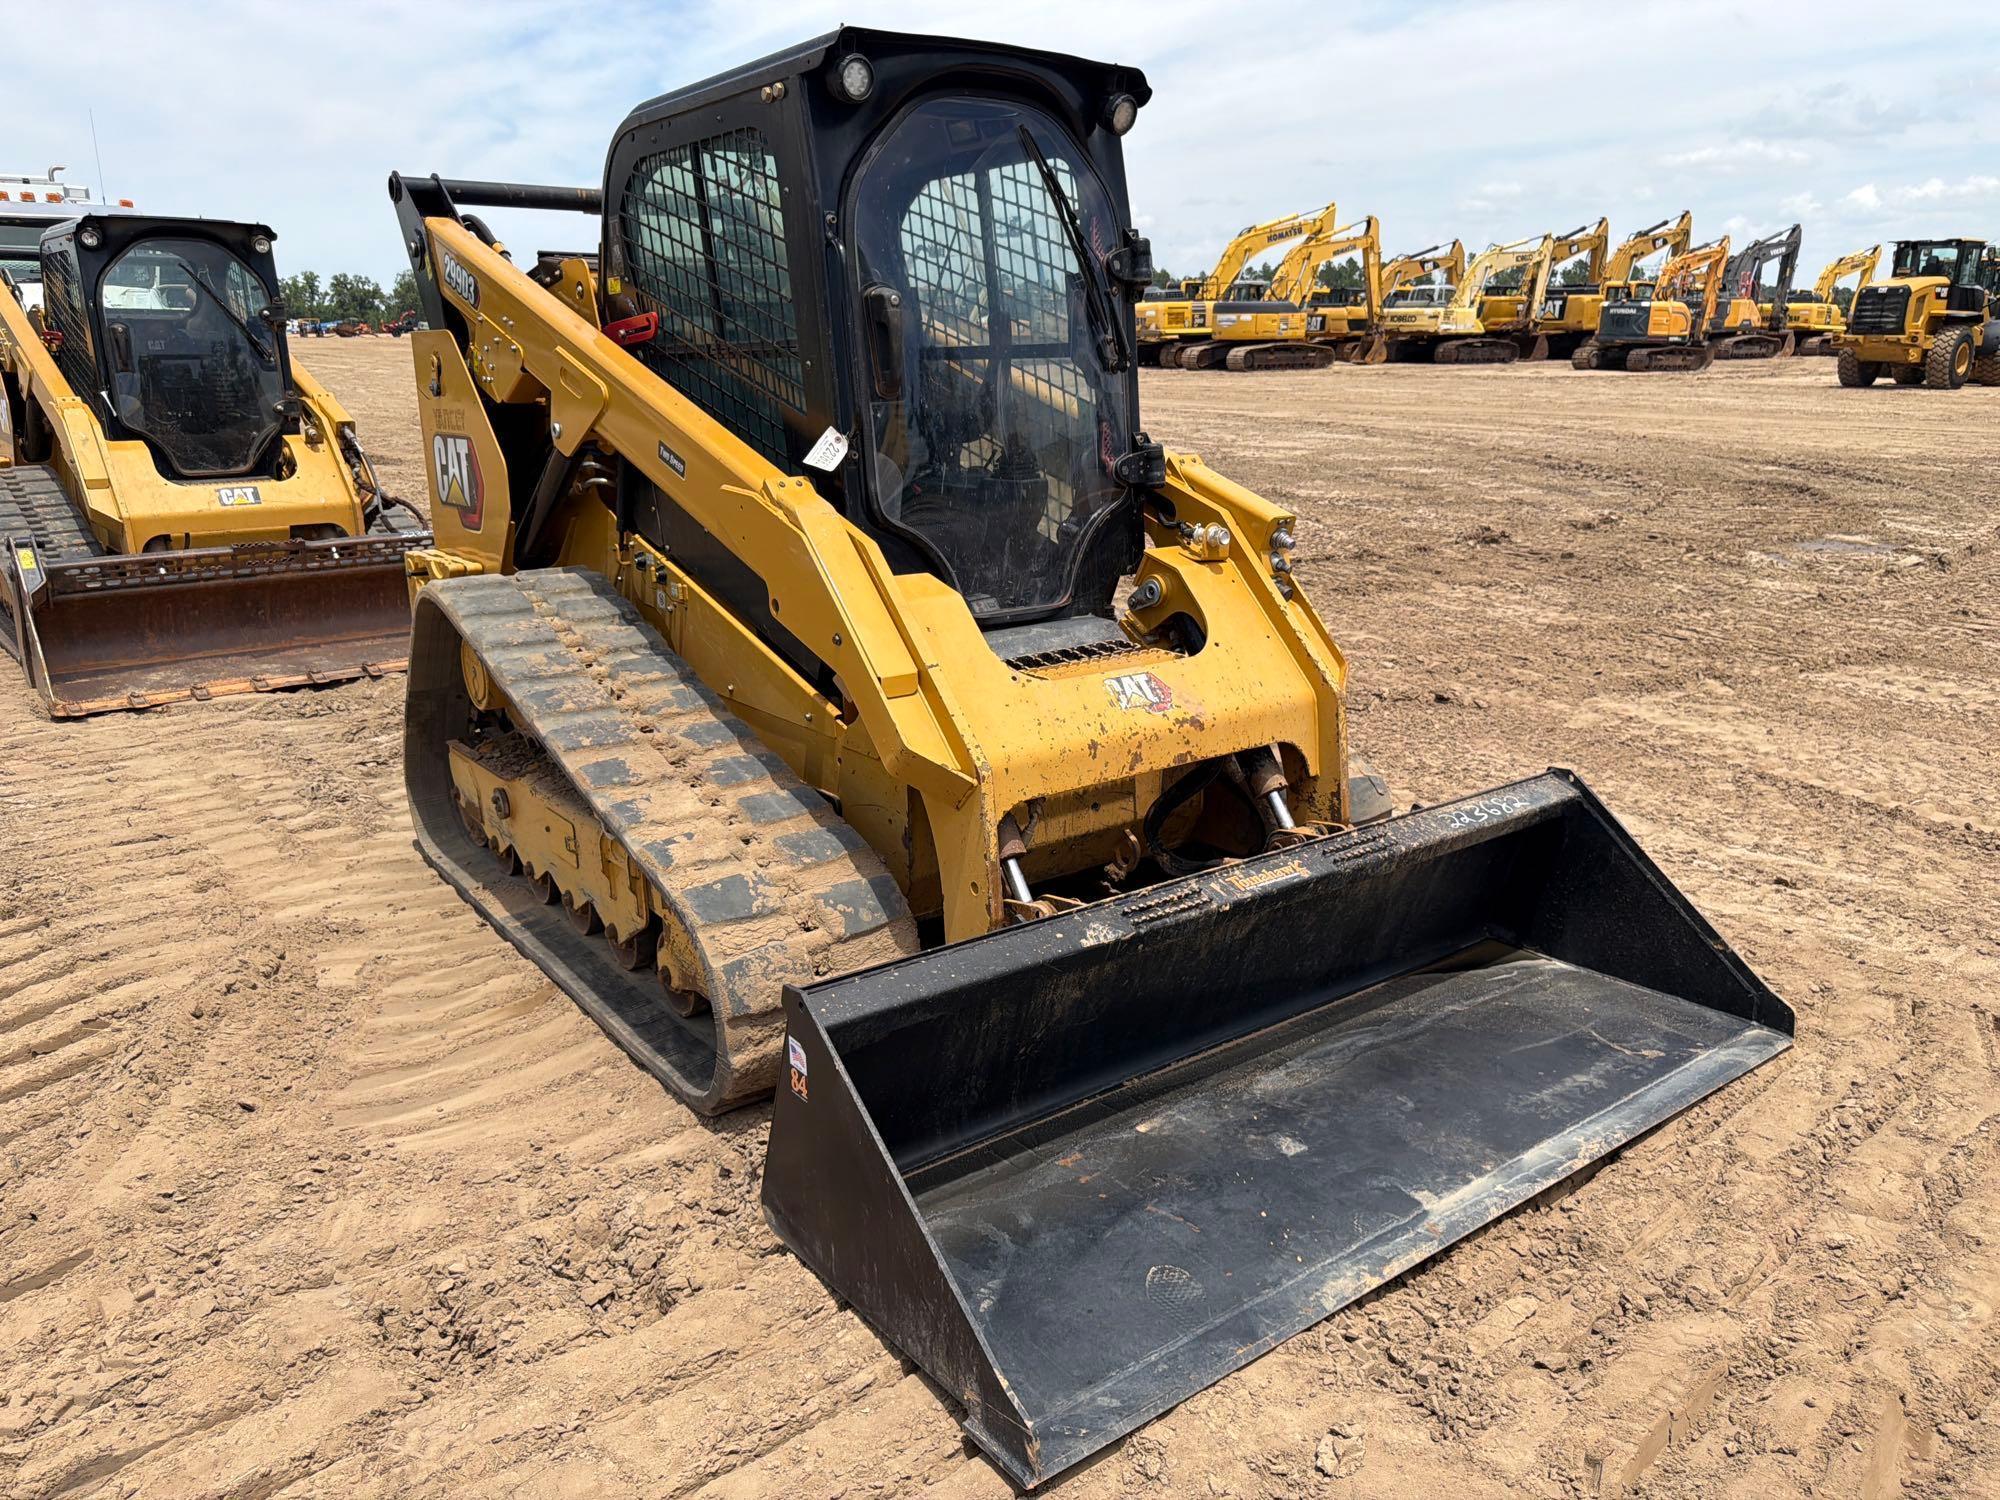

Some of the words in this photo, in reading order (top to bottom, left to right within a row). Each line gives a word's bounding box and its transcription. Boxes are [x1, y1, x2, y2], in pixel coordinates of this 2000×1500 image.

[1267, 226, 1302, 243] KOMATSU
[1333, 243, 1356, 256] KOMATSU
[1770, 246, 1786, 256] VOLVO
[444, 254, 475, 305] 299D3
[433, 435, 471, 507] CAT
[220, 487, 256, 505] CAT
[1438, 796, 1530, 828] 223682
[791, 1067, 808, 1099] 84
